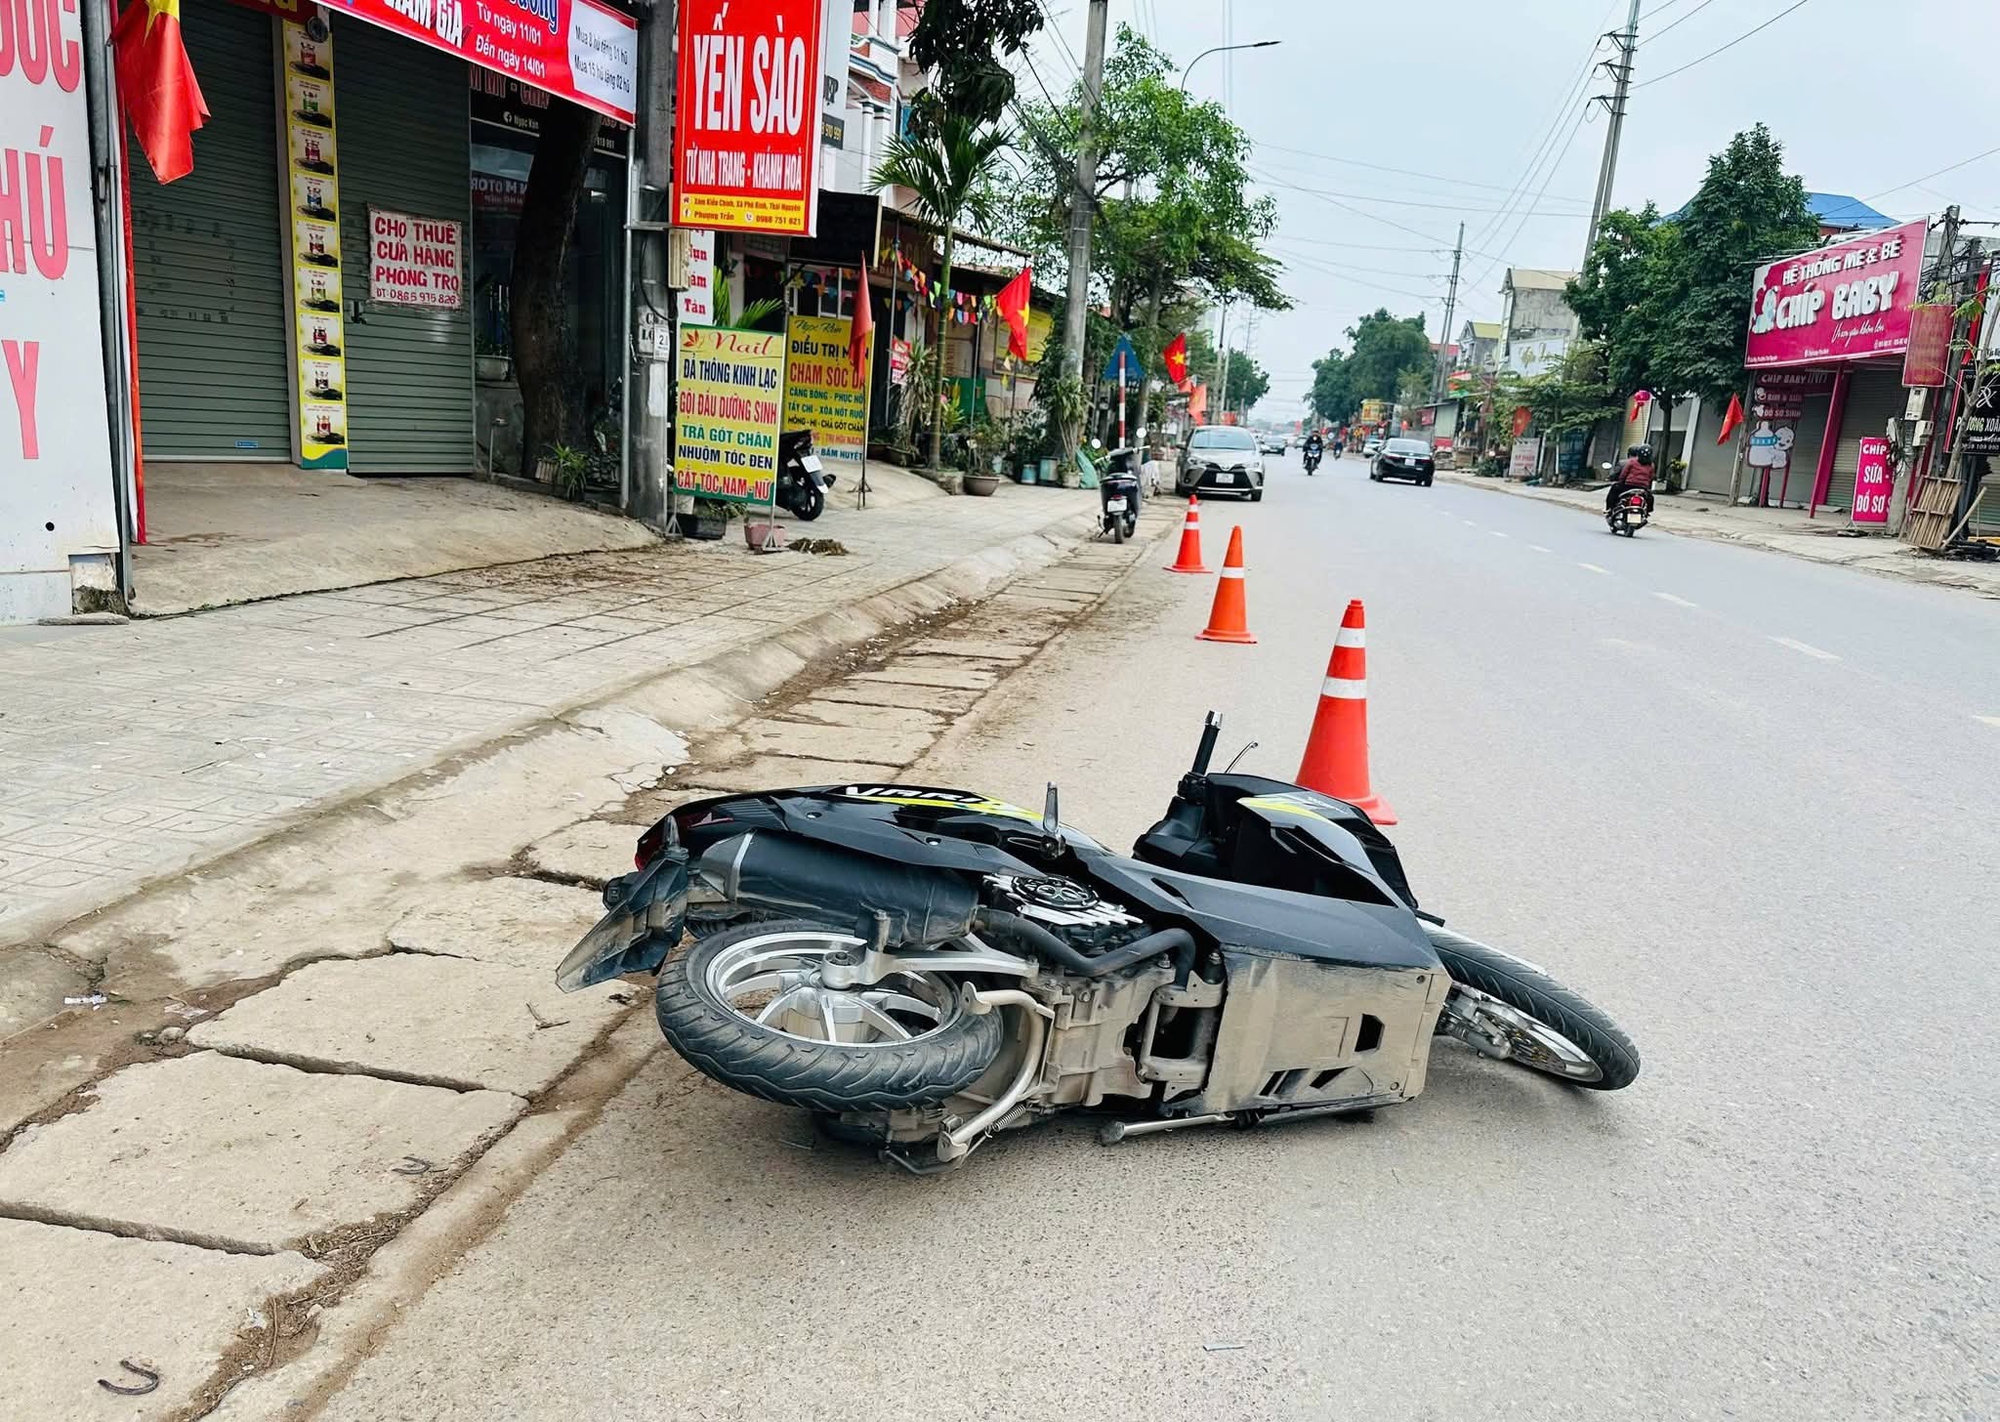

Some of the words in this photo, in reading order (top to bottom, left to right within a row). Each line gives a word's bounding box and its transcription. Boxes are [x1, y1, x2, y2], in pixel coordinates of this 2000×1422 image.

[493, 13, 517, 39] ngày
[520, 21, 542, 46] 11/01
[575, 25, 588, 45] Mua
[476, 34, 495, 58] Đến
[498, 48, 520, 72] ngày
[522, 54, 545, 78] 14/01
[693, 2, 744, 131] YẾN
[750, 15, 805, 136] SÀO
[574, 54, 587, 74] Mua
[617, 74, 622, 90] 02
[698, 149, 716, 186] NHA
[718, 151, 746, 188] TRANG
[752, 145, 784, 189] KHÁNH
[375, 217, 407, 238] CHO
[413, 222, 456, 245] THUÊ
[774, 216, 787, 224] 751
[413, 245, 454, 268] HÀNG
[1783, 265, 1799, 287] HỆ
[1800, 254, 1841, 281] THỐNG
[1844, 250, 1866, 271] MẸ
[1866, 248, 1878, 263] &
[1881, 236, 1902, 260] BÉ
[1776, 283, 1825, 329] CHÍP
[1832, 271, 1899, 320] BABY
[709, 332, 774, 355] Nail
[821, 344, 839, 362] TRỊ
[699, 357, 730, 383] THÔNG
[733, 364, 756, 386] KINH
[759, 367, 777, 393] LẠC
[790, 361, 822, 384] CHĂM
[826, 363, 849, 387] SÓC
[2, 340, 39, 460] Y
[680, 388, 695, 419] GỘI
[754, 400, 777, 425] SINH
[710, 427, 733, 443] GÓT
[737, 431, 772, 449] CHÂN
[1862, 443, 1887, 455] CHÍP
[679, 445, 720, 464] NHUỘM
[724, 449, 746, 466] TÓC
[749, 454, 773, 469] ĐEN
[700, 470, 719, 492] TÓC
[723, 476, 747, 496] NAM
[1864, 463, 1883, 484] SỮA
[1871, 494, 1886, 513] SƠ
